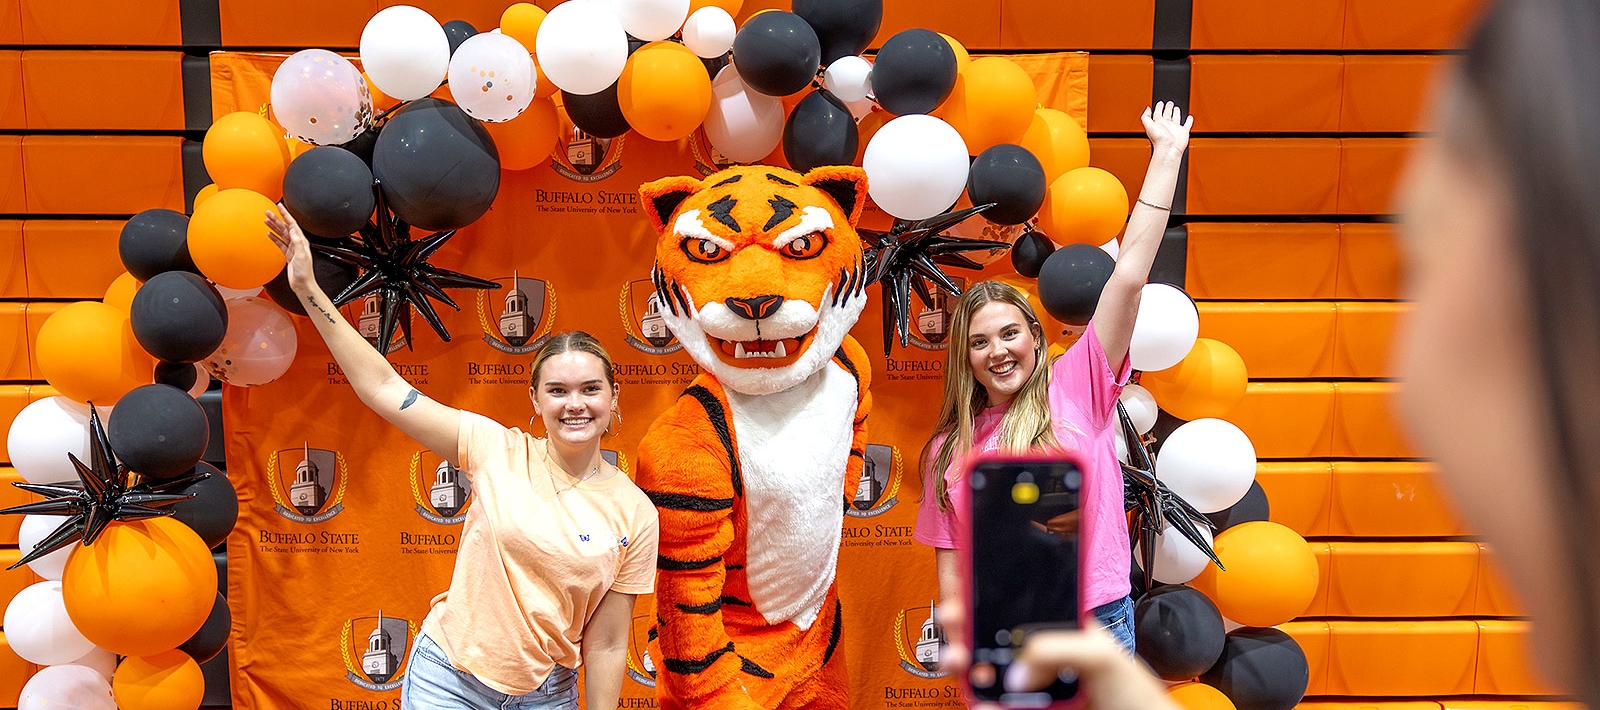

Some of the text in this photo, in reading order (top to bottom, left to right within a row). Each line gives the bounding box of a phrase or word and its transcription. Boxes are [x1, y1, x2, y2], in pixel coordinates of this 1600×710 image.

[535, 189, 638, 205] BUFFALO STATE
[550, 205, 565, 213] State
[566, 206, 597, 215] University
[467, 362, 525, 376] BUFFALO
[671, 362, 701, 375] STAT
[886, 358, 942, 372] BUFFALO
[328, 377, 341, 385] The
[469, 377, 482, 385] The
[499, 378, 529, 386] University
[641, 378, 671, 386] University
[259, 530, 360, 545] BUFFALO STATE
[841, 524, 913, 538] FALO STATE
[400, 531, 455, 545] BUFFALO
[290, 546, 320, 555] University
[414, 547, 428, 555] State
[885, 686, 940, 699] BUFFALO
[330, 698, 388, 710] BUFFALO
